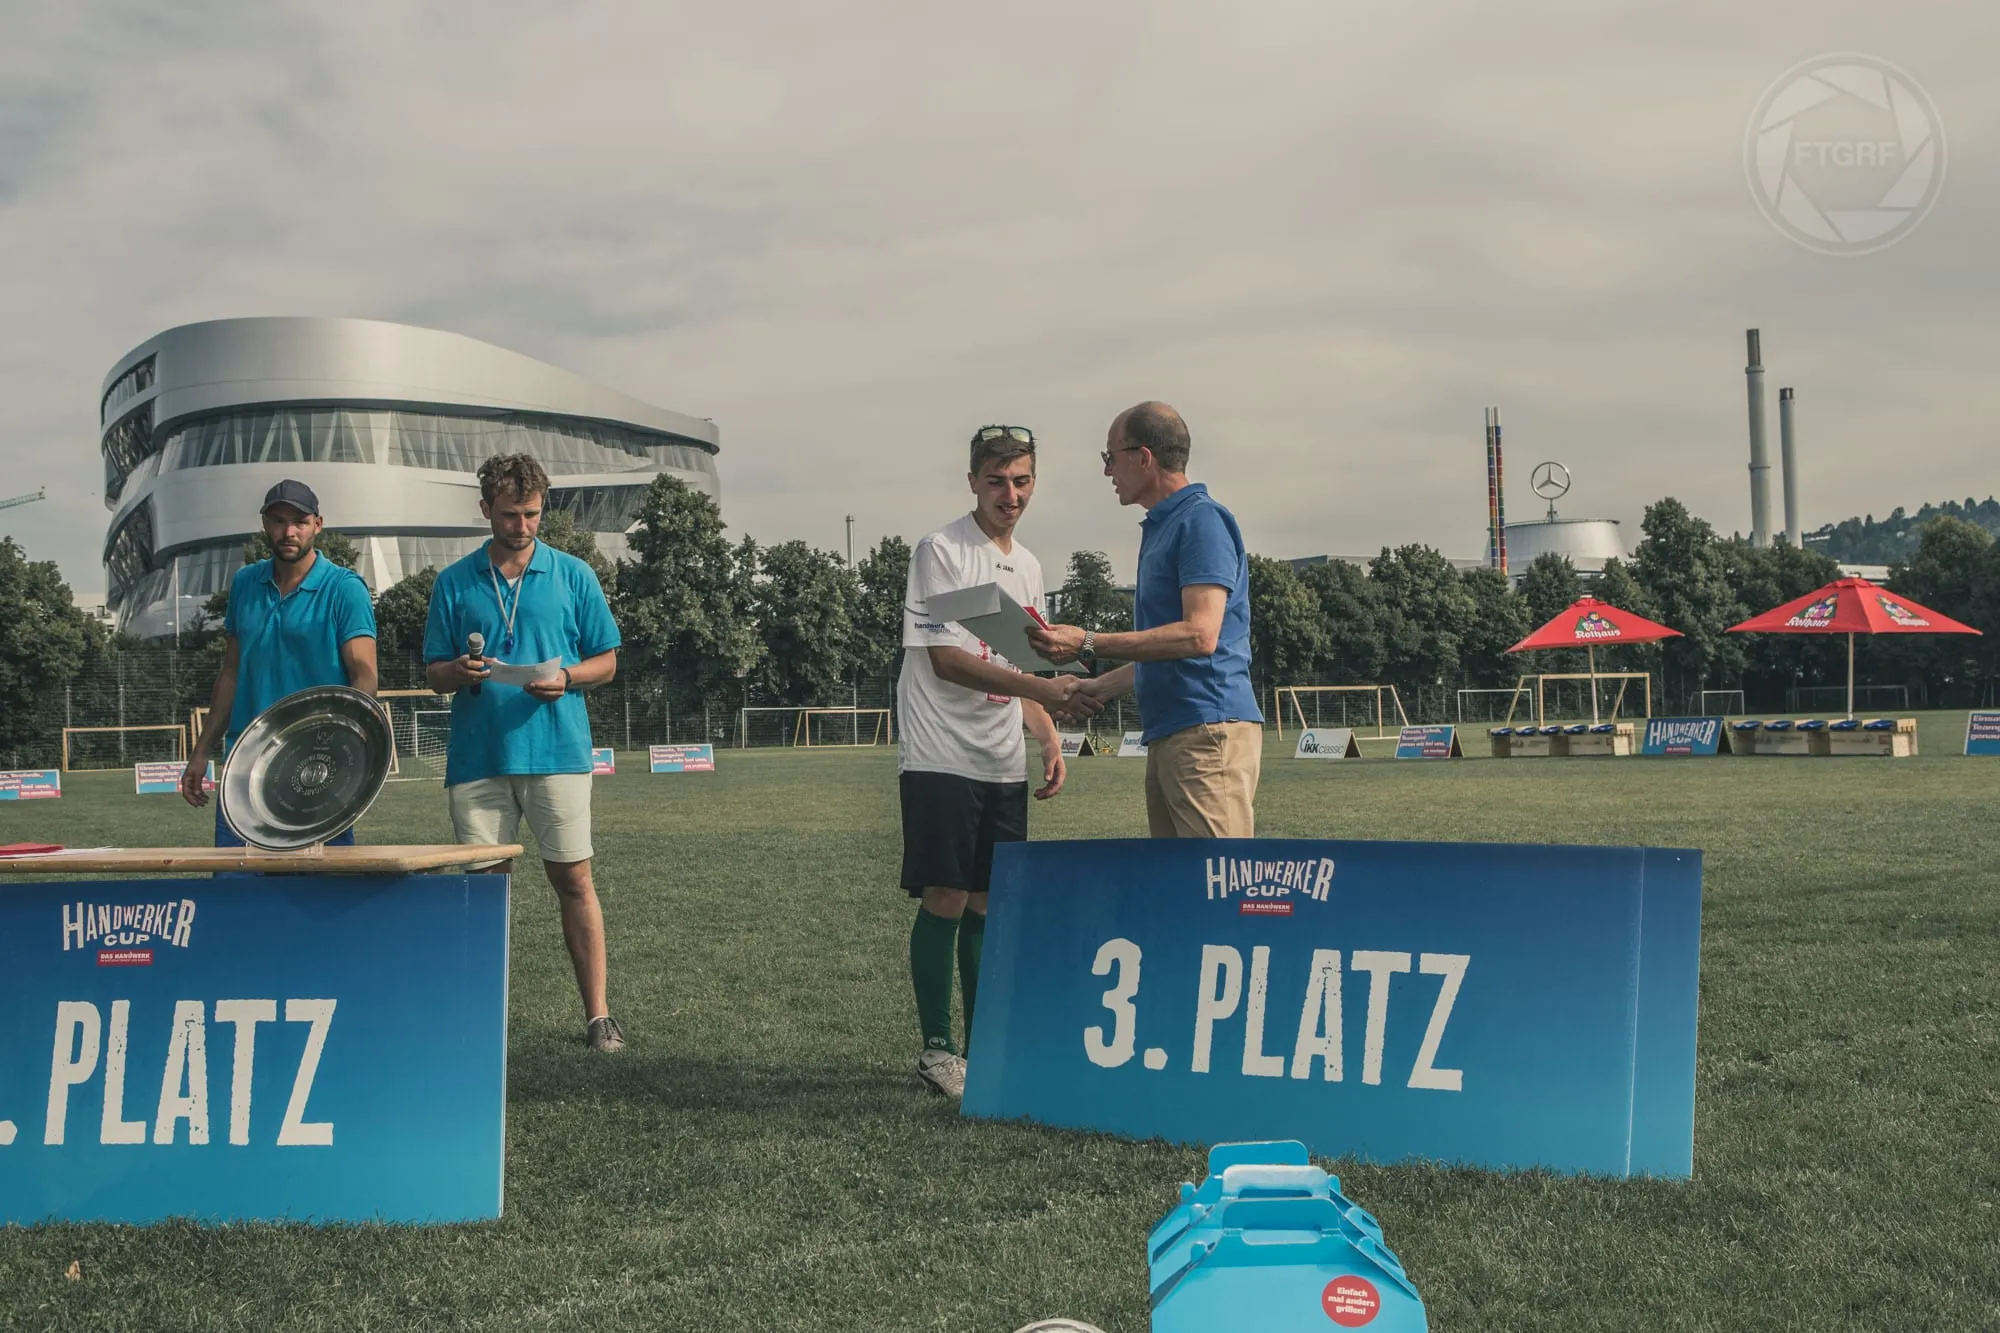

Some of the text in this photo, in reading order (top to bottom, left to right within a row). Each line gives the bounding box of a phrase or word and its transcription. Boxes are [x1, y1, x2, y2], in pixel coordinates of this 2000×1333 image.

[1649, 720, 1716, 747] HANDWERKER
[1669, 736, 1692, 744] CUP
[1206, 856, 1336, 902] HANDWERKER
[1245, 885, 1290, 898] CUP
[62, 898, 196, 951] HANDWERKER
[104, 932, 150, 946] CUP
[1084, 937, 1471, 1092] 3. PLATZ
[44, 998, 337, 1146] PLATZ
[1337, 1287, 1368, 1297] Einfach
[1328, 1295, 1375, 1307] mal anders
[1336, 1305, 1366, 1315] grillen!
